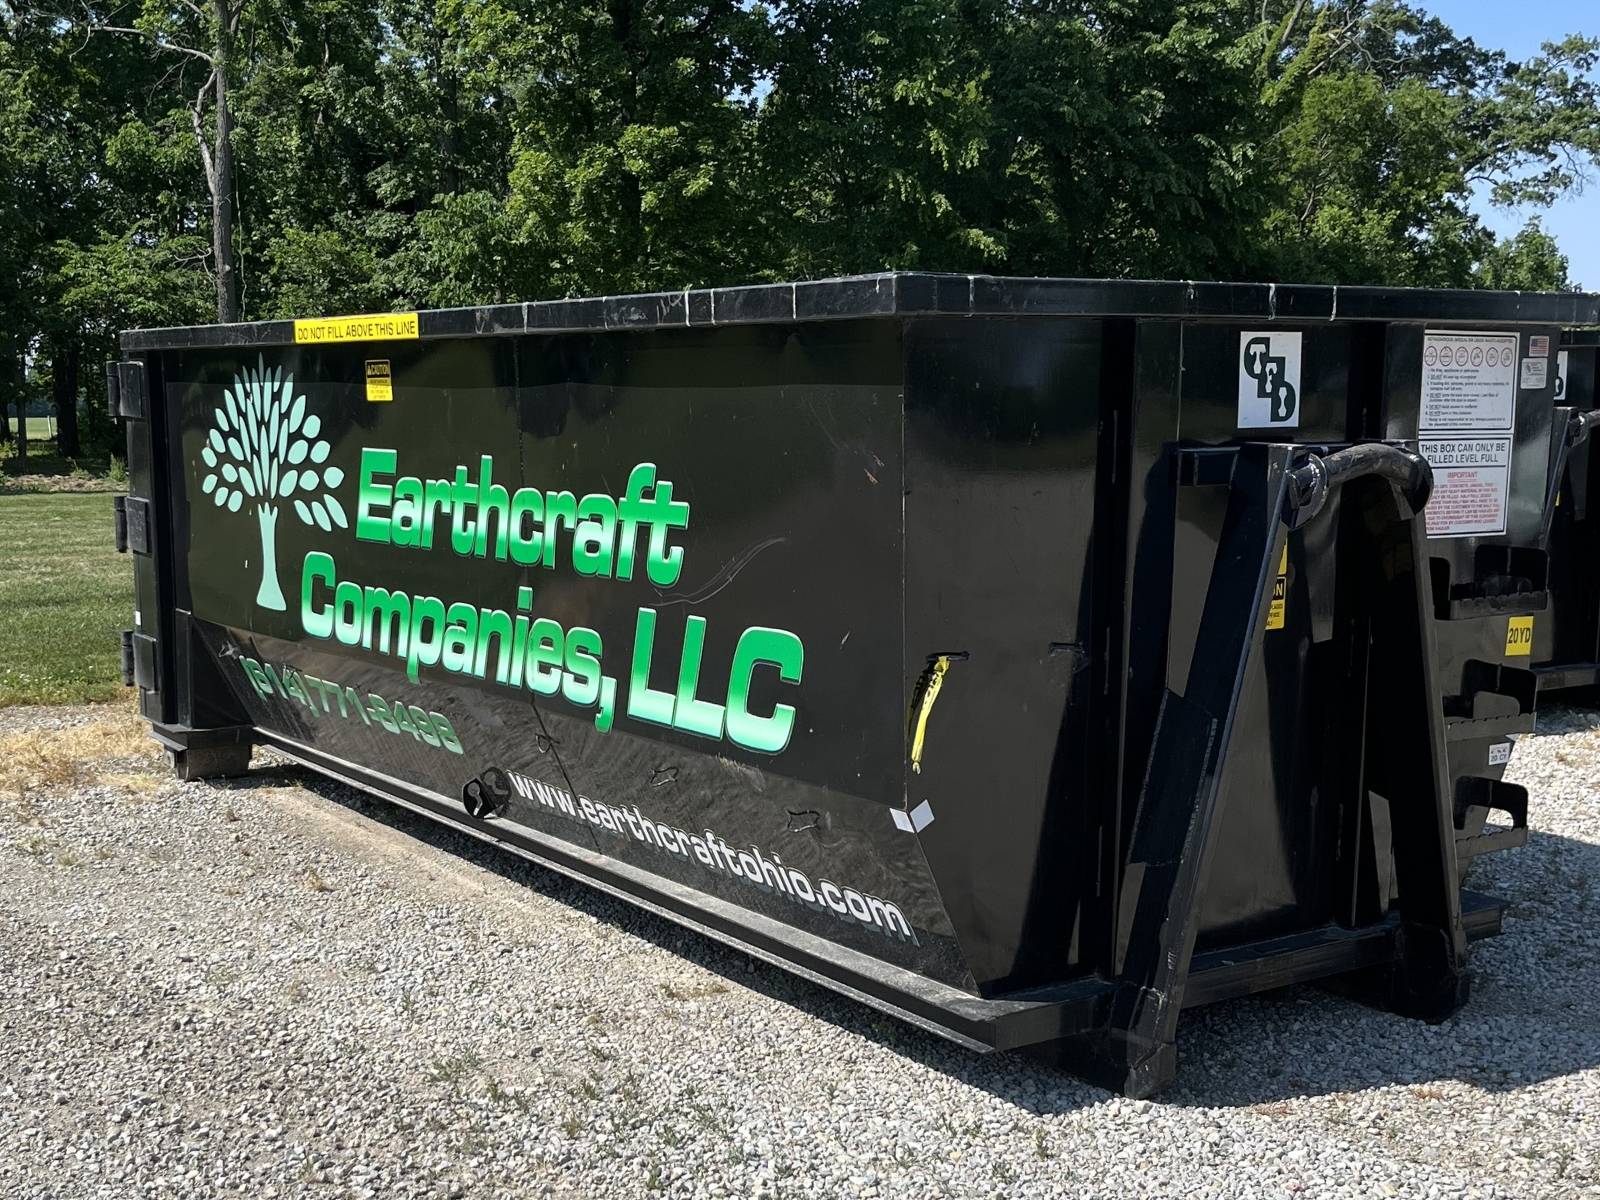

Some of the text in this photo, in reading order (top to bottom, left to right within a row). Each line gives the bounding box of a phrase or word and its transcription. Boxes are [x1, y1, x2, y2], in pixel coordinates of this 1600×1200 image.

[298, 320, 416, 340] DO NOT FILL ABOVE THIS LINE
[1421, 442, 1506, 453] THIS BOX CAN ONLY BE
[1427, 454, 1498, 464] FILLED LEVEL FULL
[356, 447, 690, 588] Earthcraft
[301, 551, 804, 756] Companies, LLC
[506, 769, 914, 939] www.earthcraftohio.com
